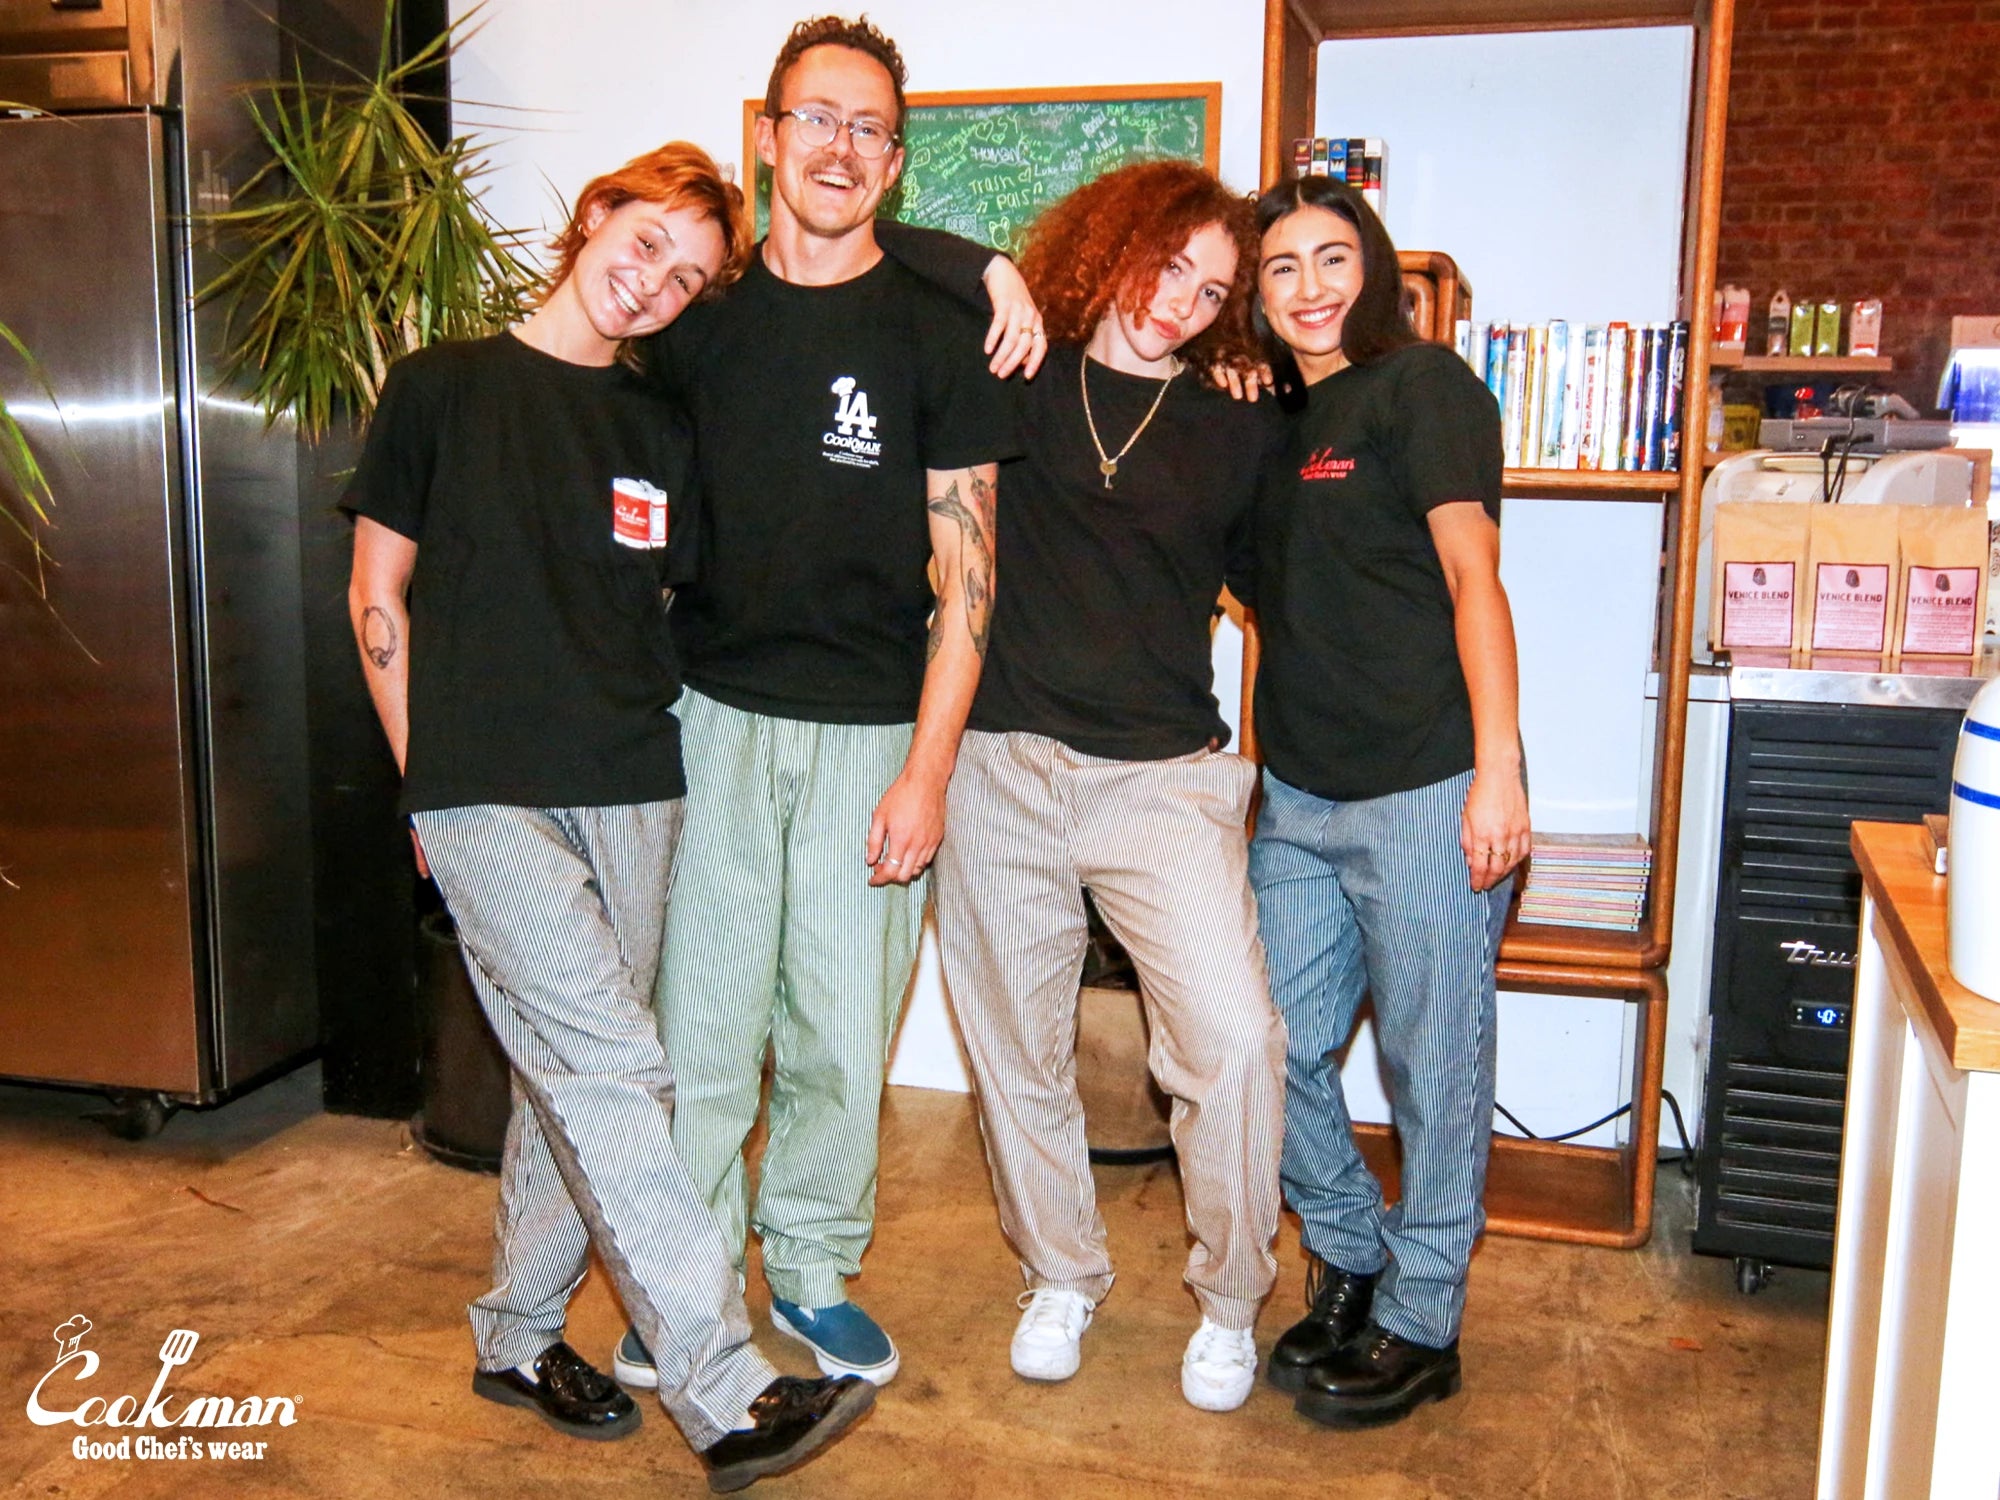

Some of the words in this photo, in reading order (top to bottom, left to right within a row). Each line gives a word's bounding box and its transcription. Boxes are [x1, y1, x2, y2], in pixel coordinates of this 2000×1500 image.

[1728, 591, 1759, 600] VENICE
[1761, 591, 1790, 600] BLEND
[1820, 592, 1851, 601] VENICE
[1854, 593, 1883, 603] BLEND
[1911, 597, 1943, 606] VENICE
[1945, 597, 1973, 606] BLEND
[1780, 941, 1857, 966] Tru
